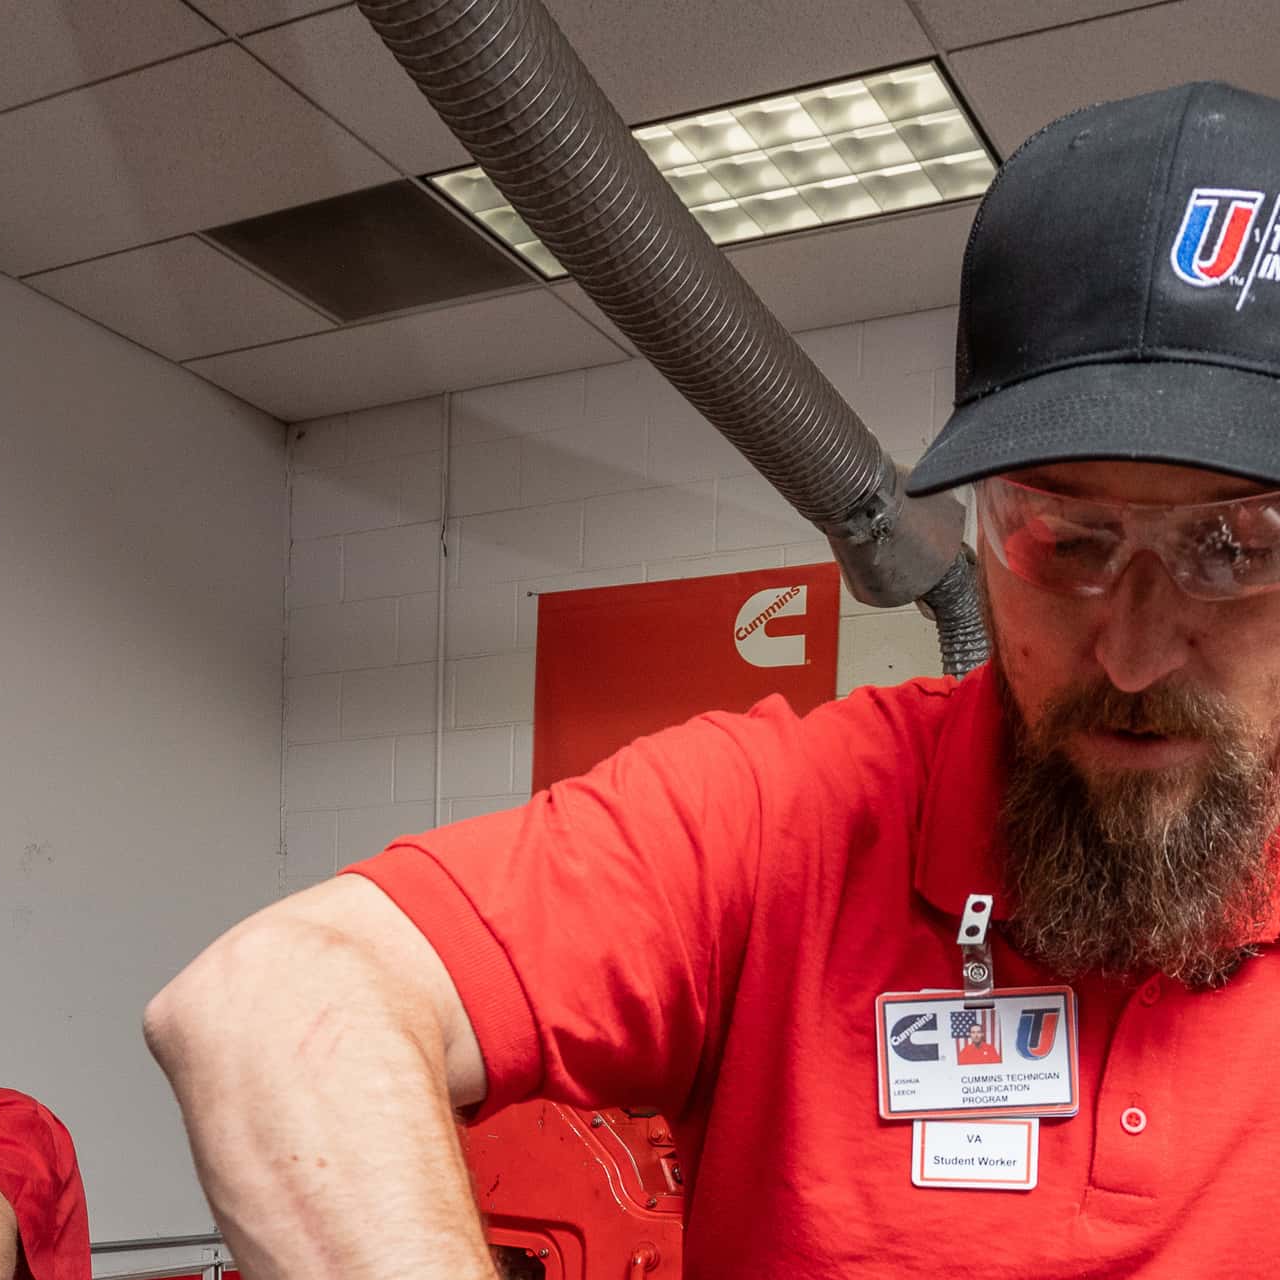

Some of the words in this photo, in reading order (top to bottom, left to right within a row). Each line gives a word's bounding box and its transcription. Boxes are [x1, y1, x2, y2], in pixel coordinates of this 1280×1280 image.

[735, 585, 801, 641] Cummins
[891, 1012, 934, 1046] Cummins
[961, 1075, 1003, 1084] CUMMINS
[1006, 1072, 1060, 1082] TECHNICIAN
[961, 1084, 1030, 1094] QUALIFICATION
[962, 1095, 1008, 1104] PROGRAM
[966, 1135, 982, 1144] VA
[933, 1156, 974, 1165] Student
[978, 1157, 1016, 1167] Worker
